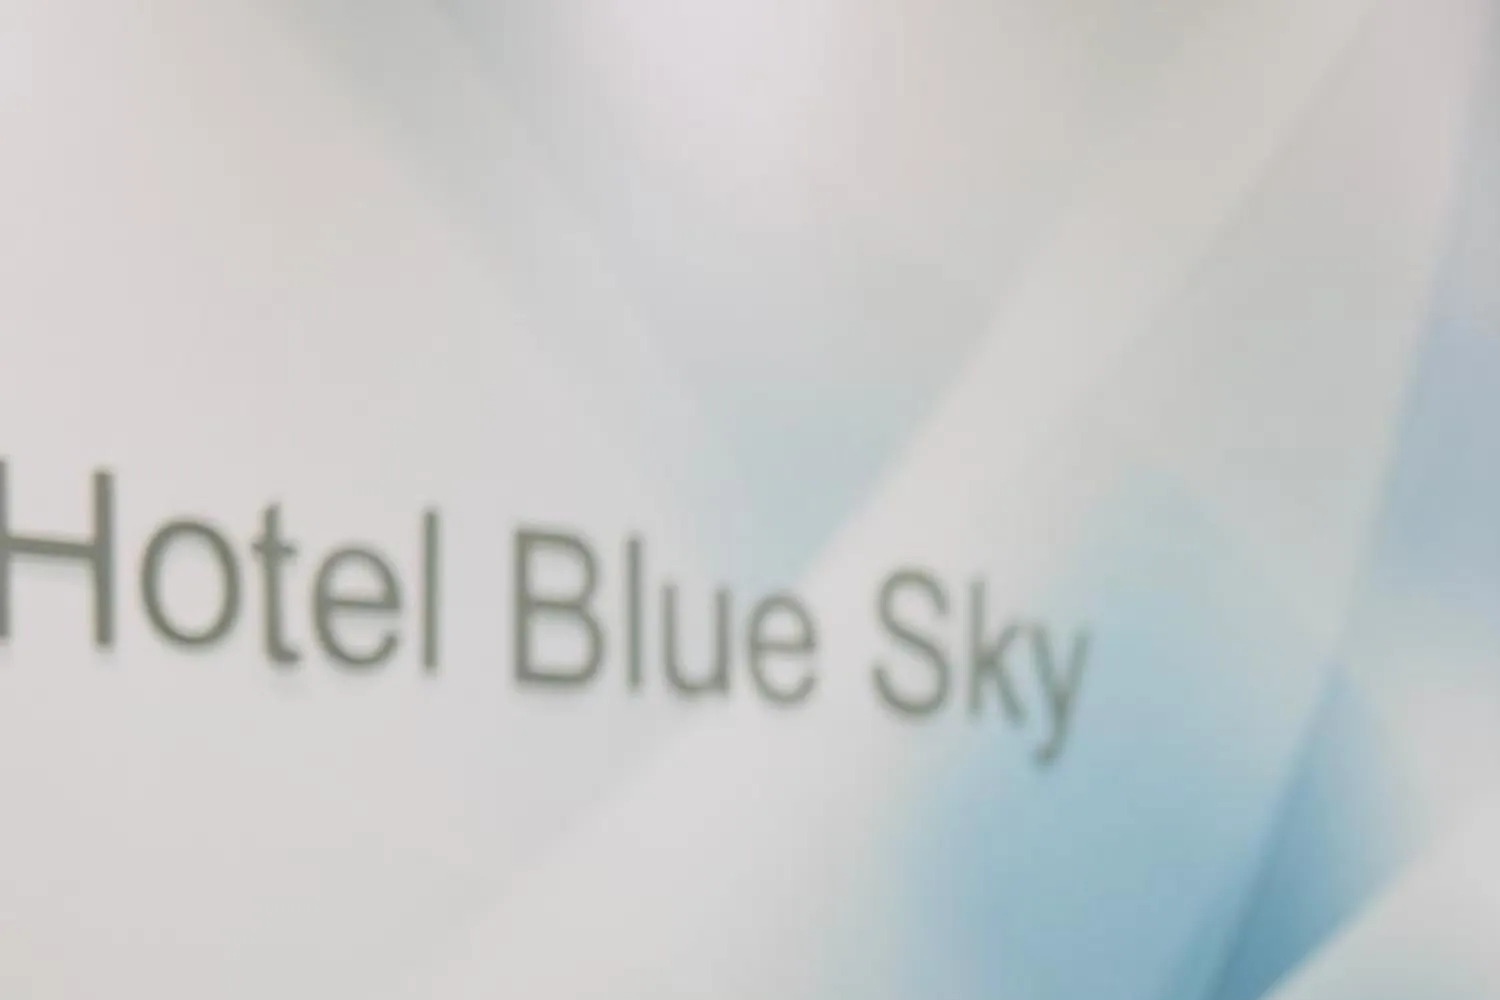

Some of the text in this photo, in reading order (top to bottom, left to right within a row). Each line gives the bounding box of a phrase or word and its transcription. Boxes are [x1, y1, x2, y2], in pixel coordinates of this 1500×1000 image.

[0, 458, 1092, 770] Hotel Blue Sky
